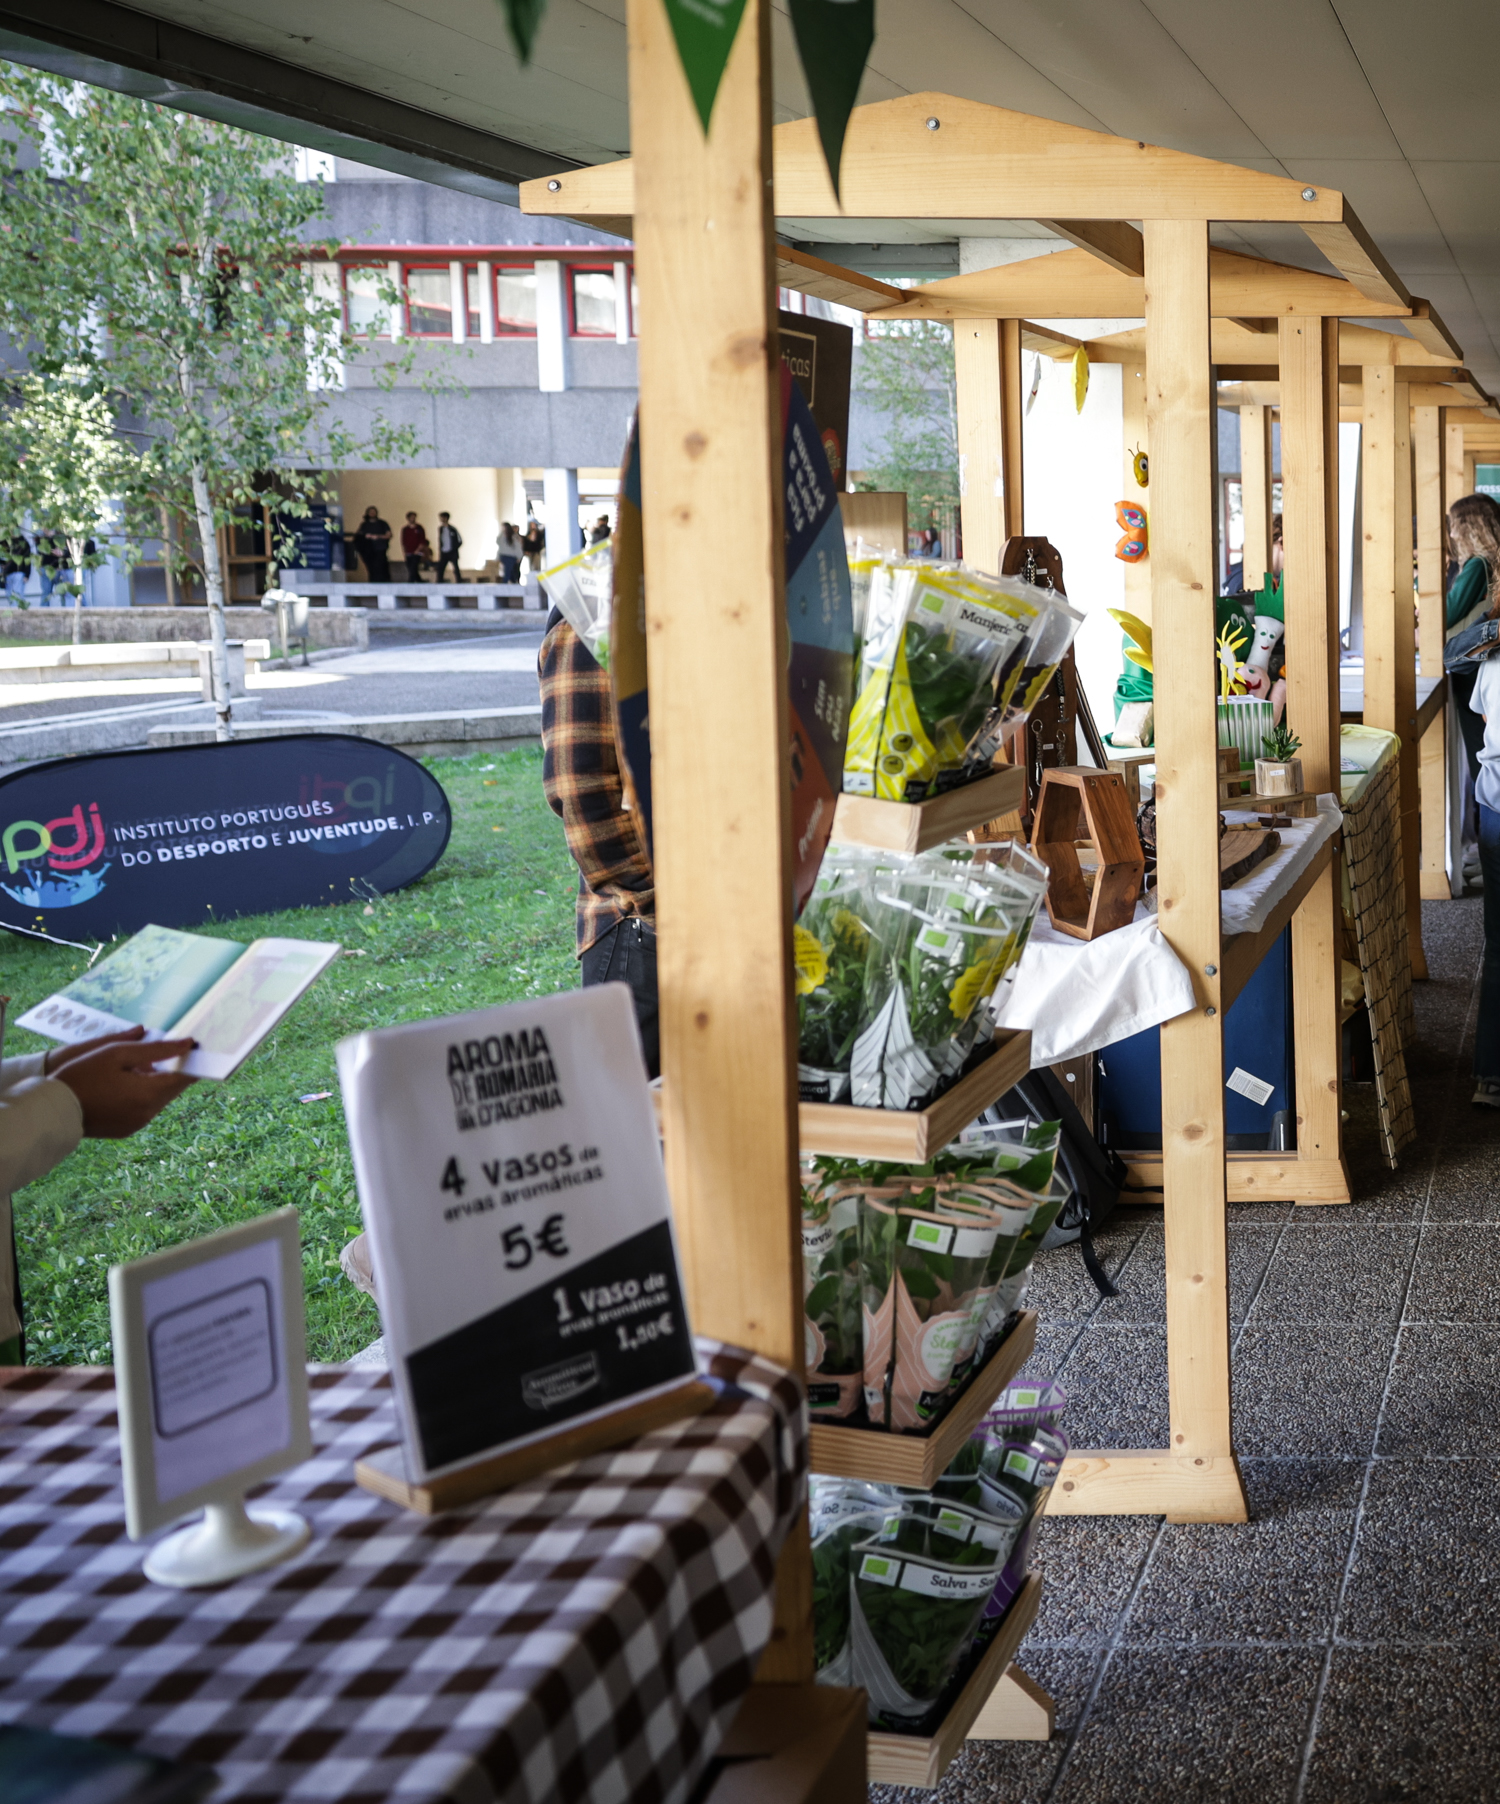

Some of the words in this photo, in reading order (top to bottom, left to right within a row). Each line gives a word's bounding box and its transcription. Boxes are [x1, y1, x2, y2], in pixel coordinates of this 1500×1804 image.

[0, 802, 105, 874] pdj
[114, 816, 216, 842] INSTITUTO
[220, 800, 334, 828] PORTUGUÊS
[121, 850, 152, 867] DO
[157, 835, 267, 863] DESPORTO
[272, 833, 282, 847] E
[422, 811, 440, 825] P.
[447, 1025, 549, 1077] AROMA
[440, 1156, 466, 1197] 4
[482, 1144, 573, 1187] vasos
[579, 1147, 598, 1163] de
[444, 1196, 496, 1223] ervas
[501, 1166, 603, 1207] aromáticas
[501, 1213, 569, 1271] 5€
[553, 1287, 573, 1323] 1
[579, 1279, 640, 1312] vaso
[643, 1273, 667, 1293] de
[930, 1574, 967, 1589] Salva
